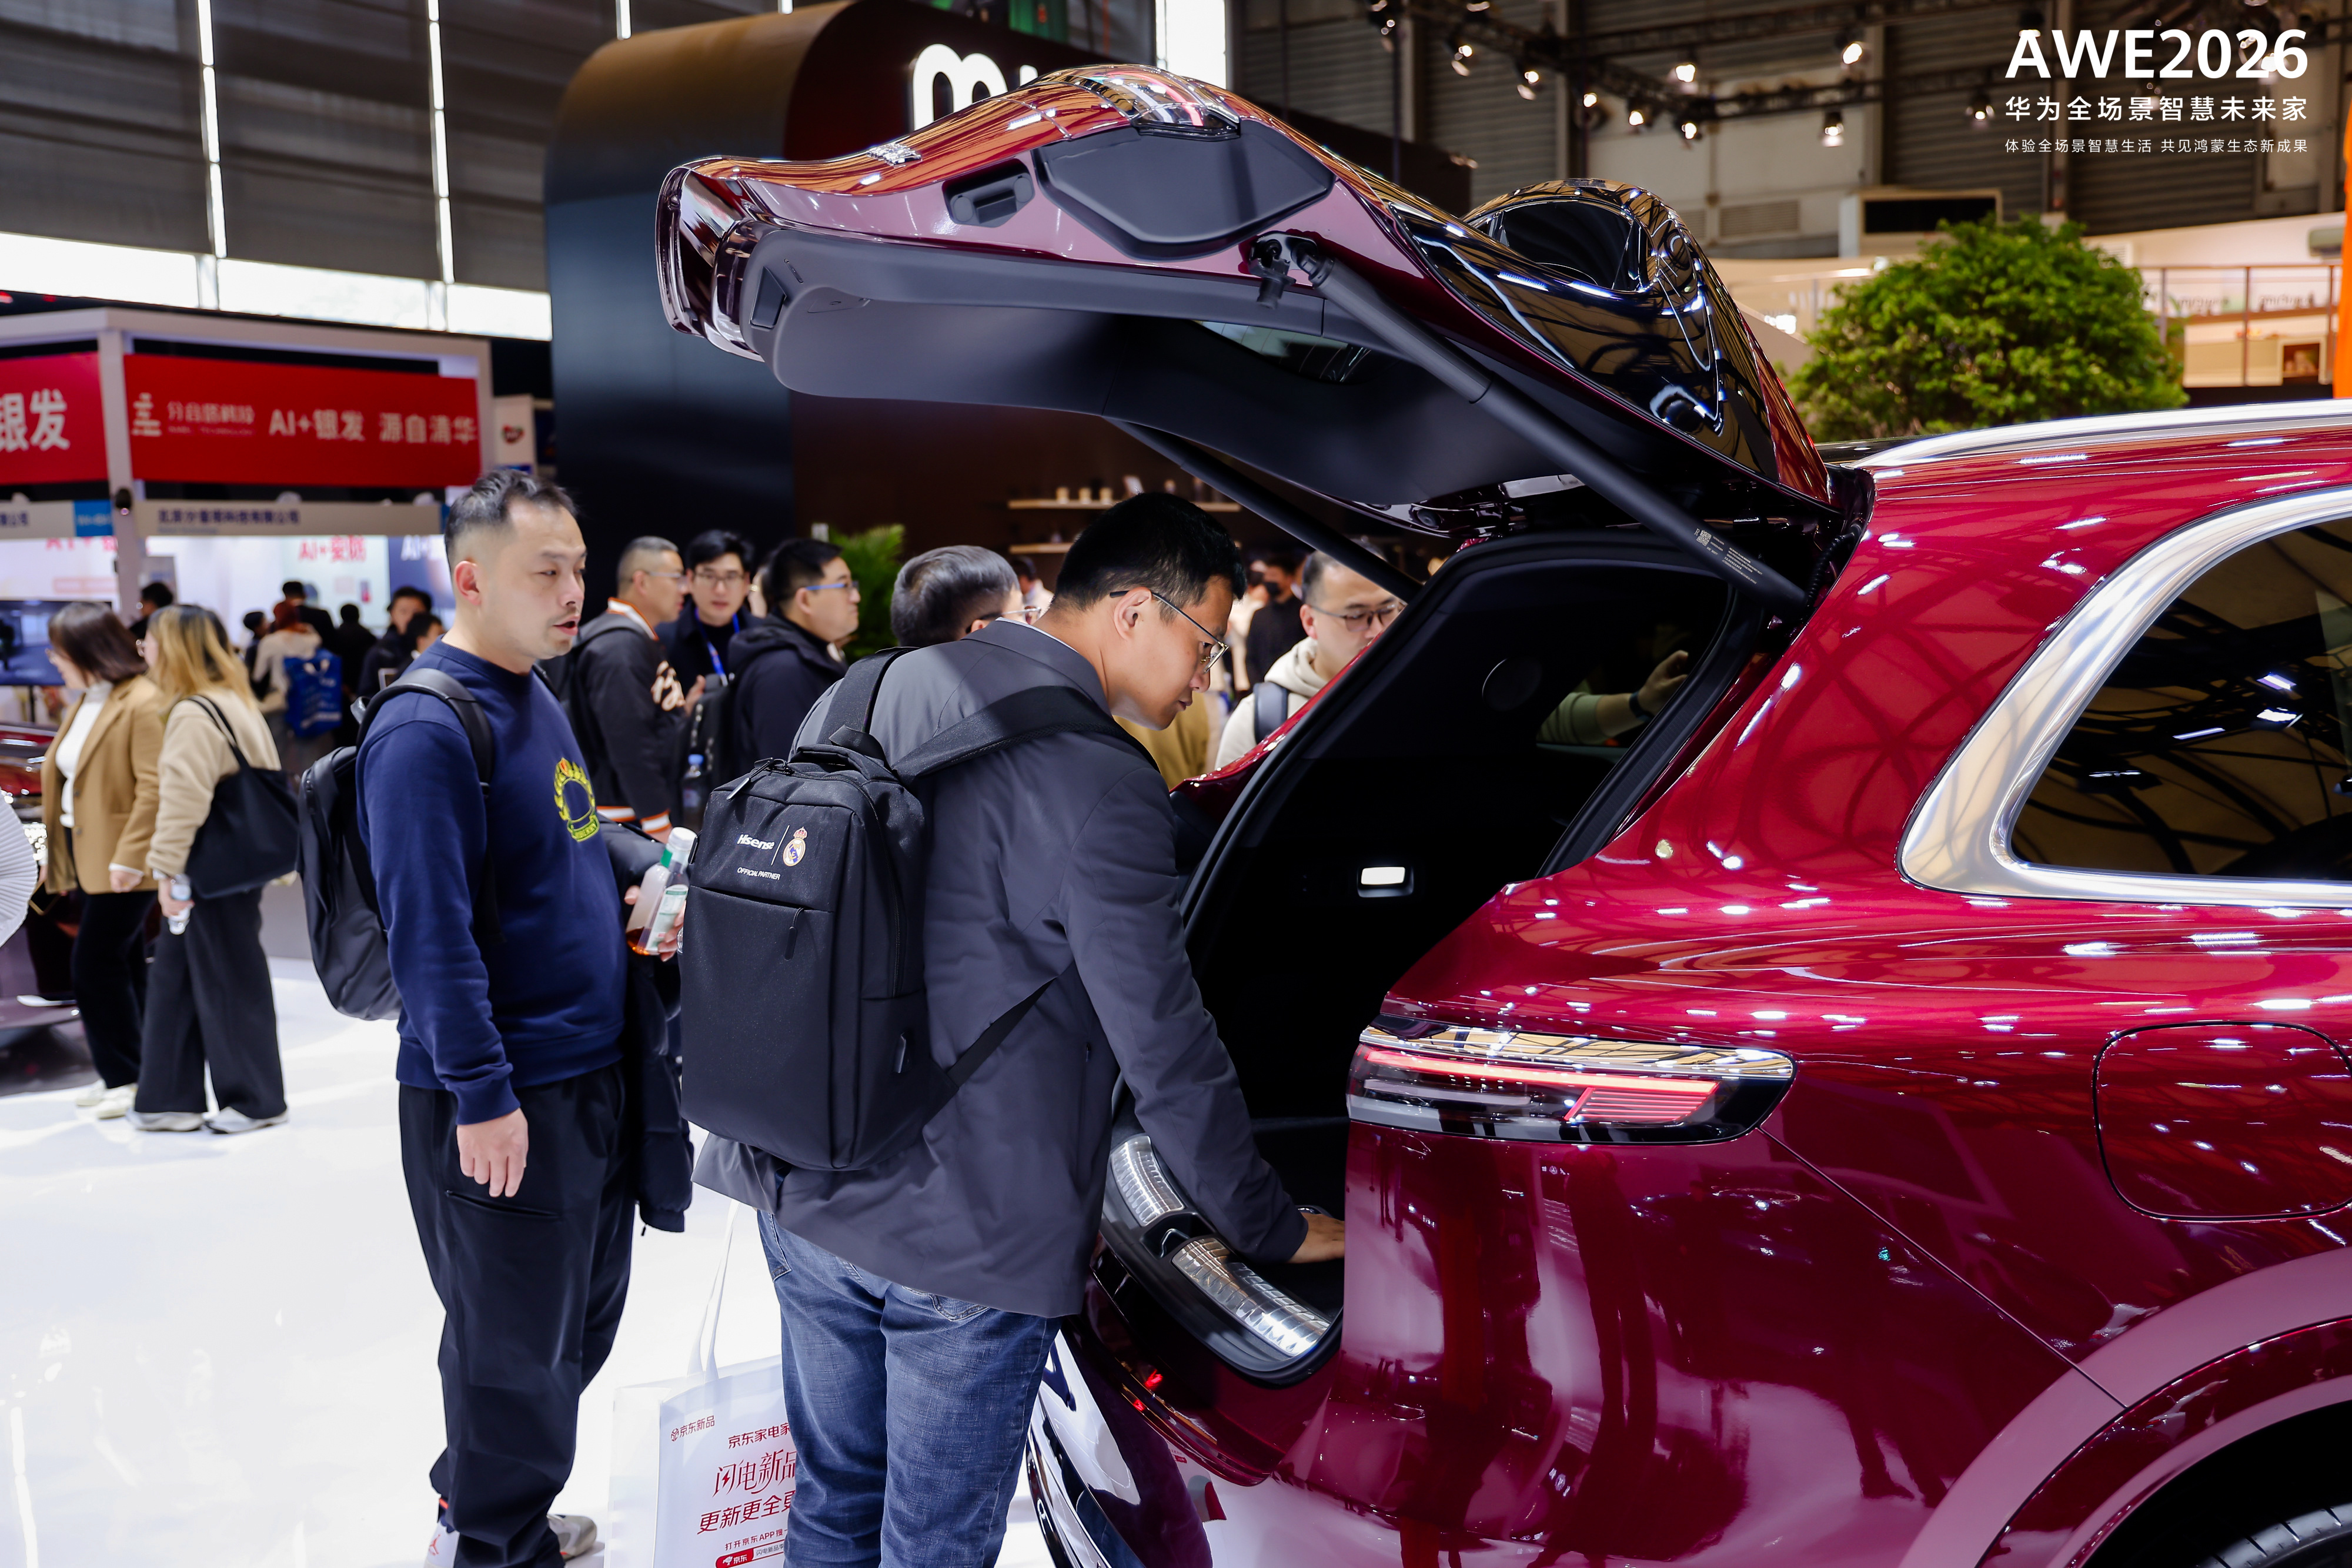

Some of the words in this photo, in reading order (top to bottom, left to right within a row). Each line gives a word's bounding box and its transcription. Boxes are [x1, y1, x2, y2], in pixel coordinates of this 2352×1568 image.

[268, 408, 365, 441] AI+银发
[379, 412, 477, 444] 源自清华
[737, 834, 775, 850] Hisense
[737, 867, 758, 877] OFFICIAL
[757, 870, 781, 881] PARTNER
[680, 1415, 715, 1438] 京东新品
[712, 1449, 797, 1498] 闪电新品
[733, 1554, 748, 1564] 京东
